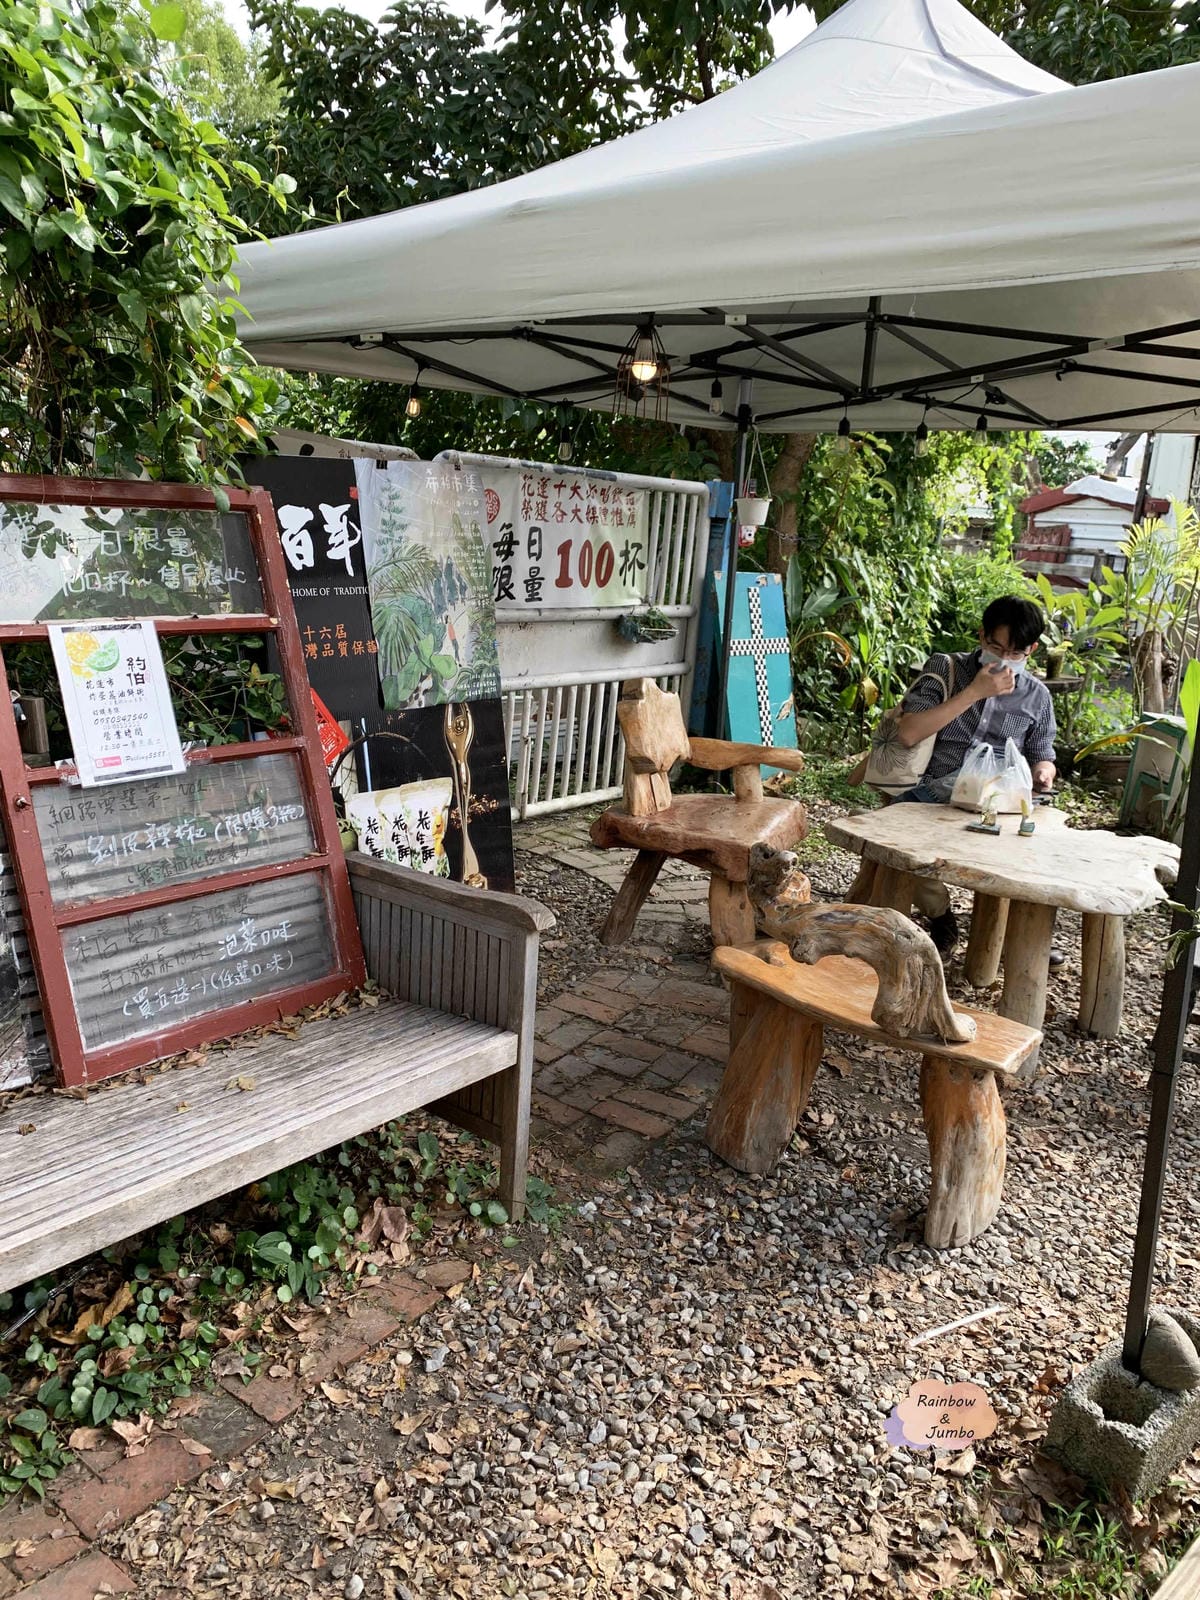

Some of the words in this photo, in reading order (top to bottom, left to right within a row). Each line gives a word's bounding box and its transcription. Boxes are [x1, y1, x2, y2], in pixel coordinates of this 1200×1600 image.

[554, 539, 615, 589] 100
[619, 539, 646, 587] 杯
[292, 587, 318, 597] HOME
[319, 587, 330, 596] OF
